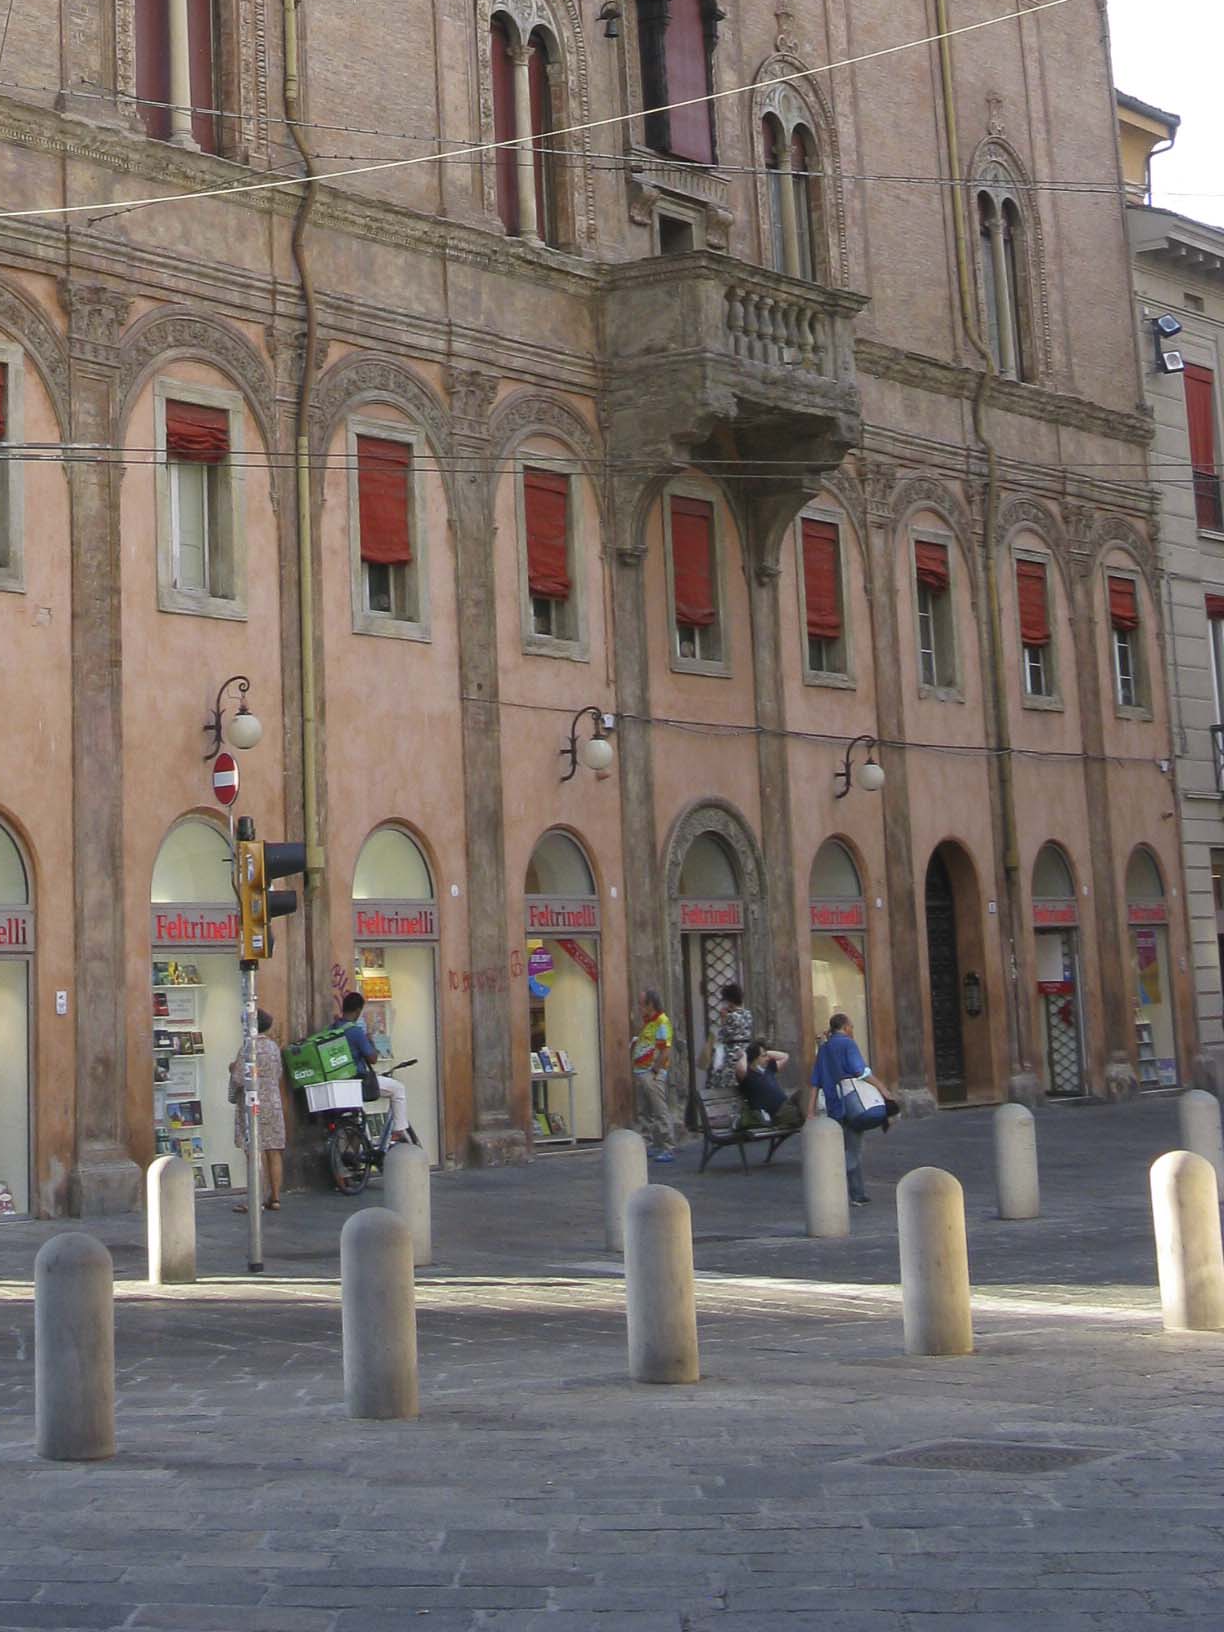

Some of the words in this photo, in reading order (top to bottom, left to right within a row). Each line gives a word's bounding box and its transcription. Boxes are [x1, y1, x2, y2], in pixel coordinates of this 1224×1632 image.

[357, 911, 433, 935] Feltrinelli
[529, 904, 596, 927] Feltrinelli
[680, 903, 741, 925] Feltrinelli
[809, 904, 863, 925] Feltrinelli
[156, 912, 239, 940] Feltrinell
